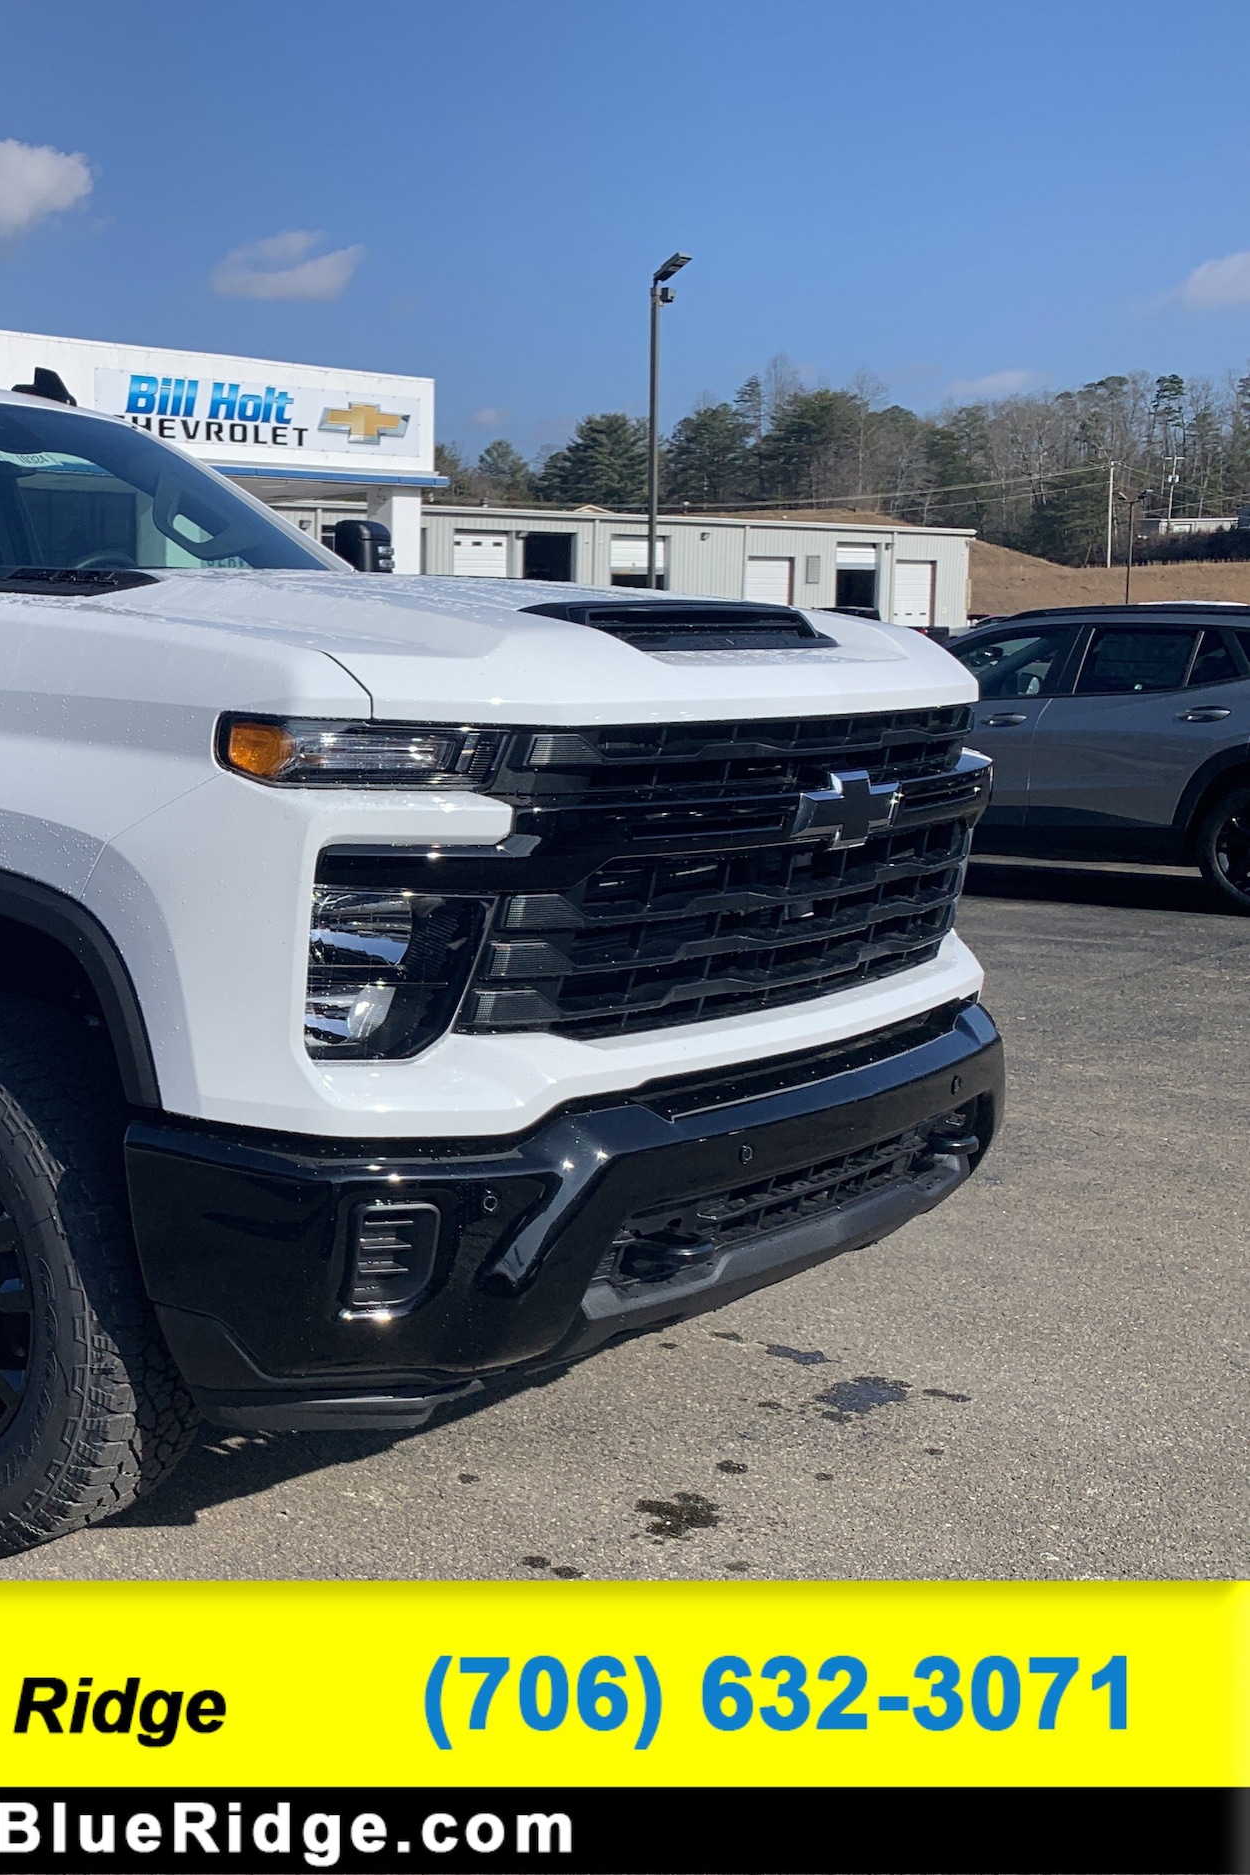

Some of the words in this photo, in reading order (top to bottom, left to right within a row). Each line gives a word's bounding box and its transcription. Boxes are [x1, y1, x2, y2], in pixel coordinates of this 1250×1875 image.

[125, 375, 199, 417] Bill
[207, 382, 294, 424] Holt
[114, 416, 309, 447] HEVROLET
